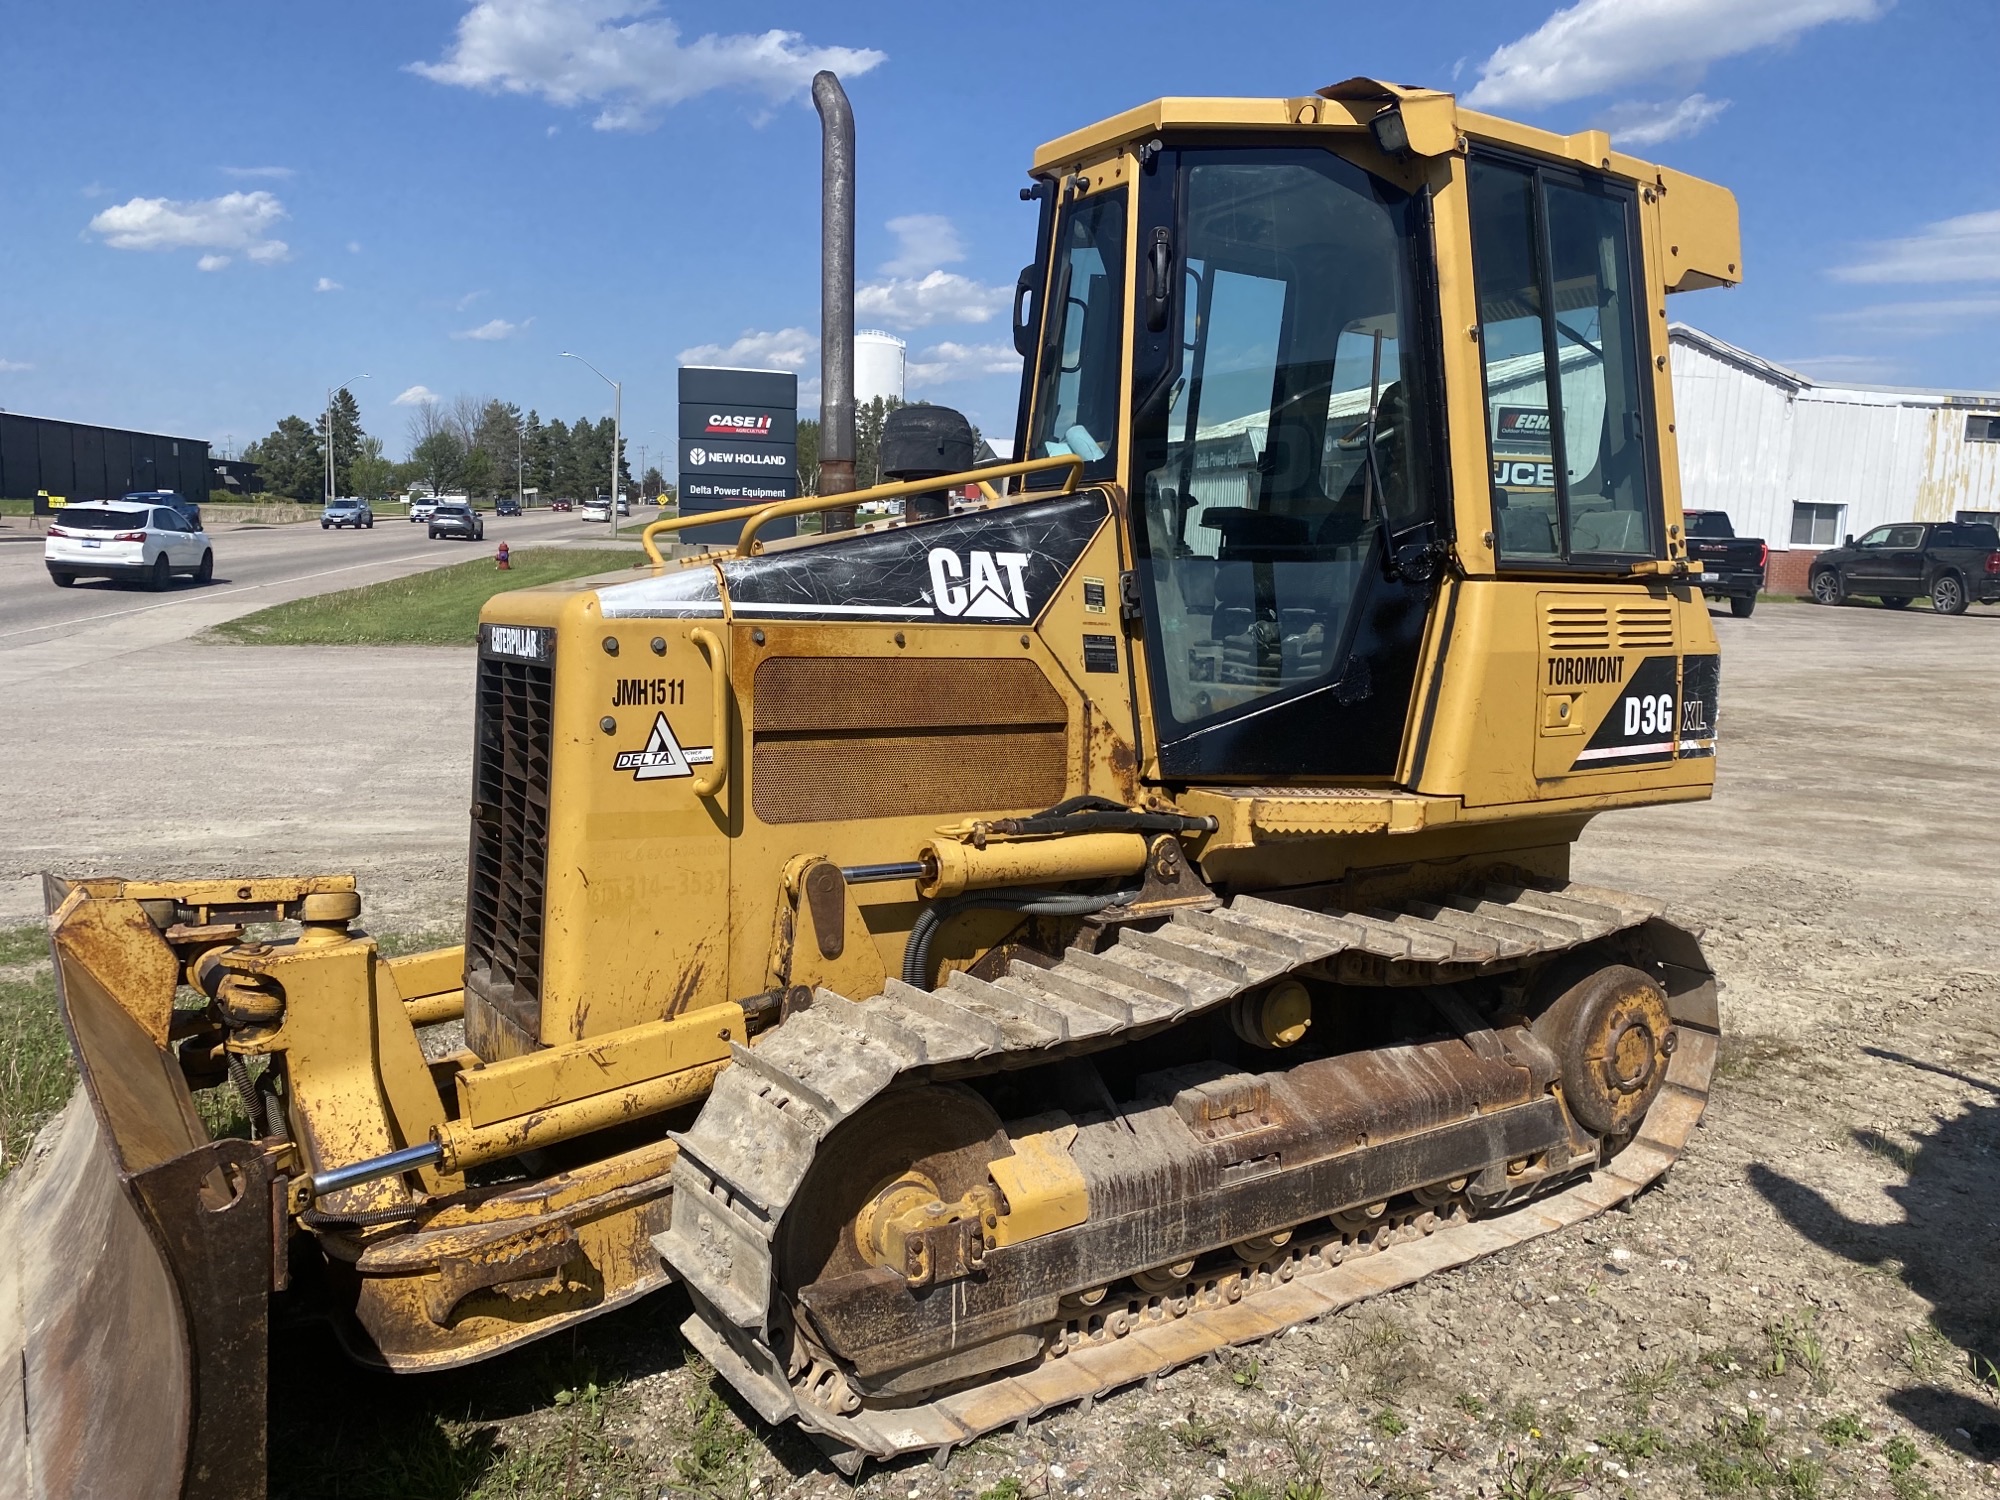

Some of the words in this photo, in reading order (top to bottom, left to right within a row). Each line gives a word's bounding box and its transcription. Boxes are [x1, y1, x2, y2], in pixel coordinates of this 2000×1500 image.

[709, 414, 755, 427] CASE
[1515, 414, 1550, 429] ECH
[708, 453, 734, 464] NEW
[735, 454, 786, 466] HOLLAND
[1196, 453, 1209, 469] Delta
[1209, 451, 1226, 467] Power
[690, 485, 712, 495] Delta
[713, 486, 741, 496] Power
[742, 487, 786, 499] Equipment
[1699, 544, 1728, 552] GMC
[927, 547, 1030, 619] CAT
[491, 626, 538, 658] CATERPILLAR
[1548, 656, 1625, 686] TOROMONT
[612, 679, 684, 707] JMH1511
[1624, 693, 1673, 736] D3G
[1682, 700, 1707, 731] XL
[618, 751, 671, 767] DELTA
[590, 848, 632, 864] SEPTIC
[647, 844, 726, 862] EXCAVATION
